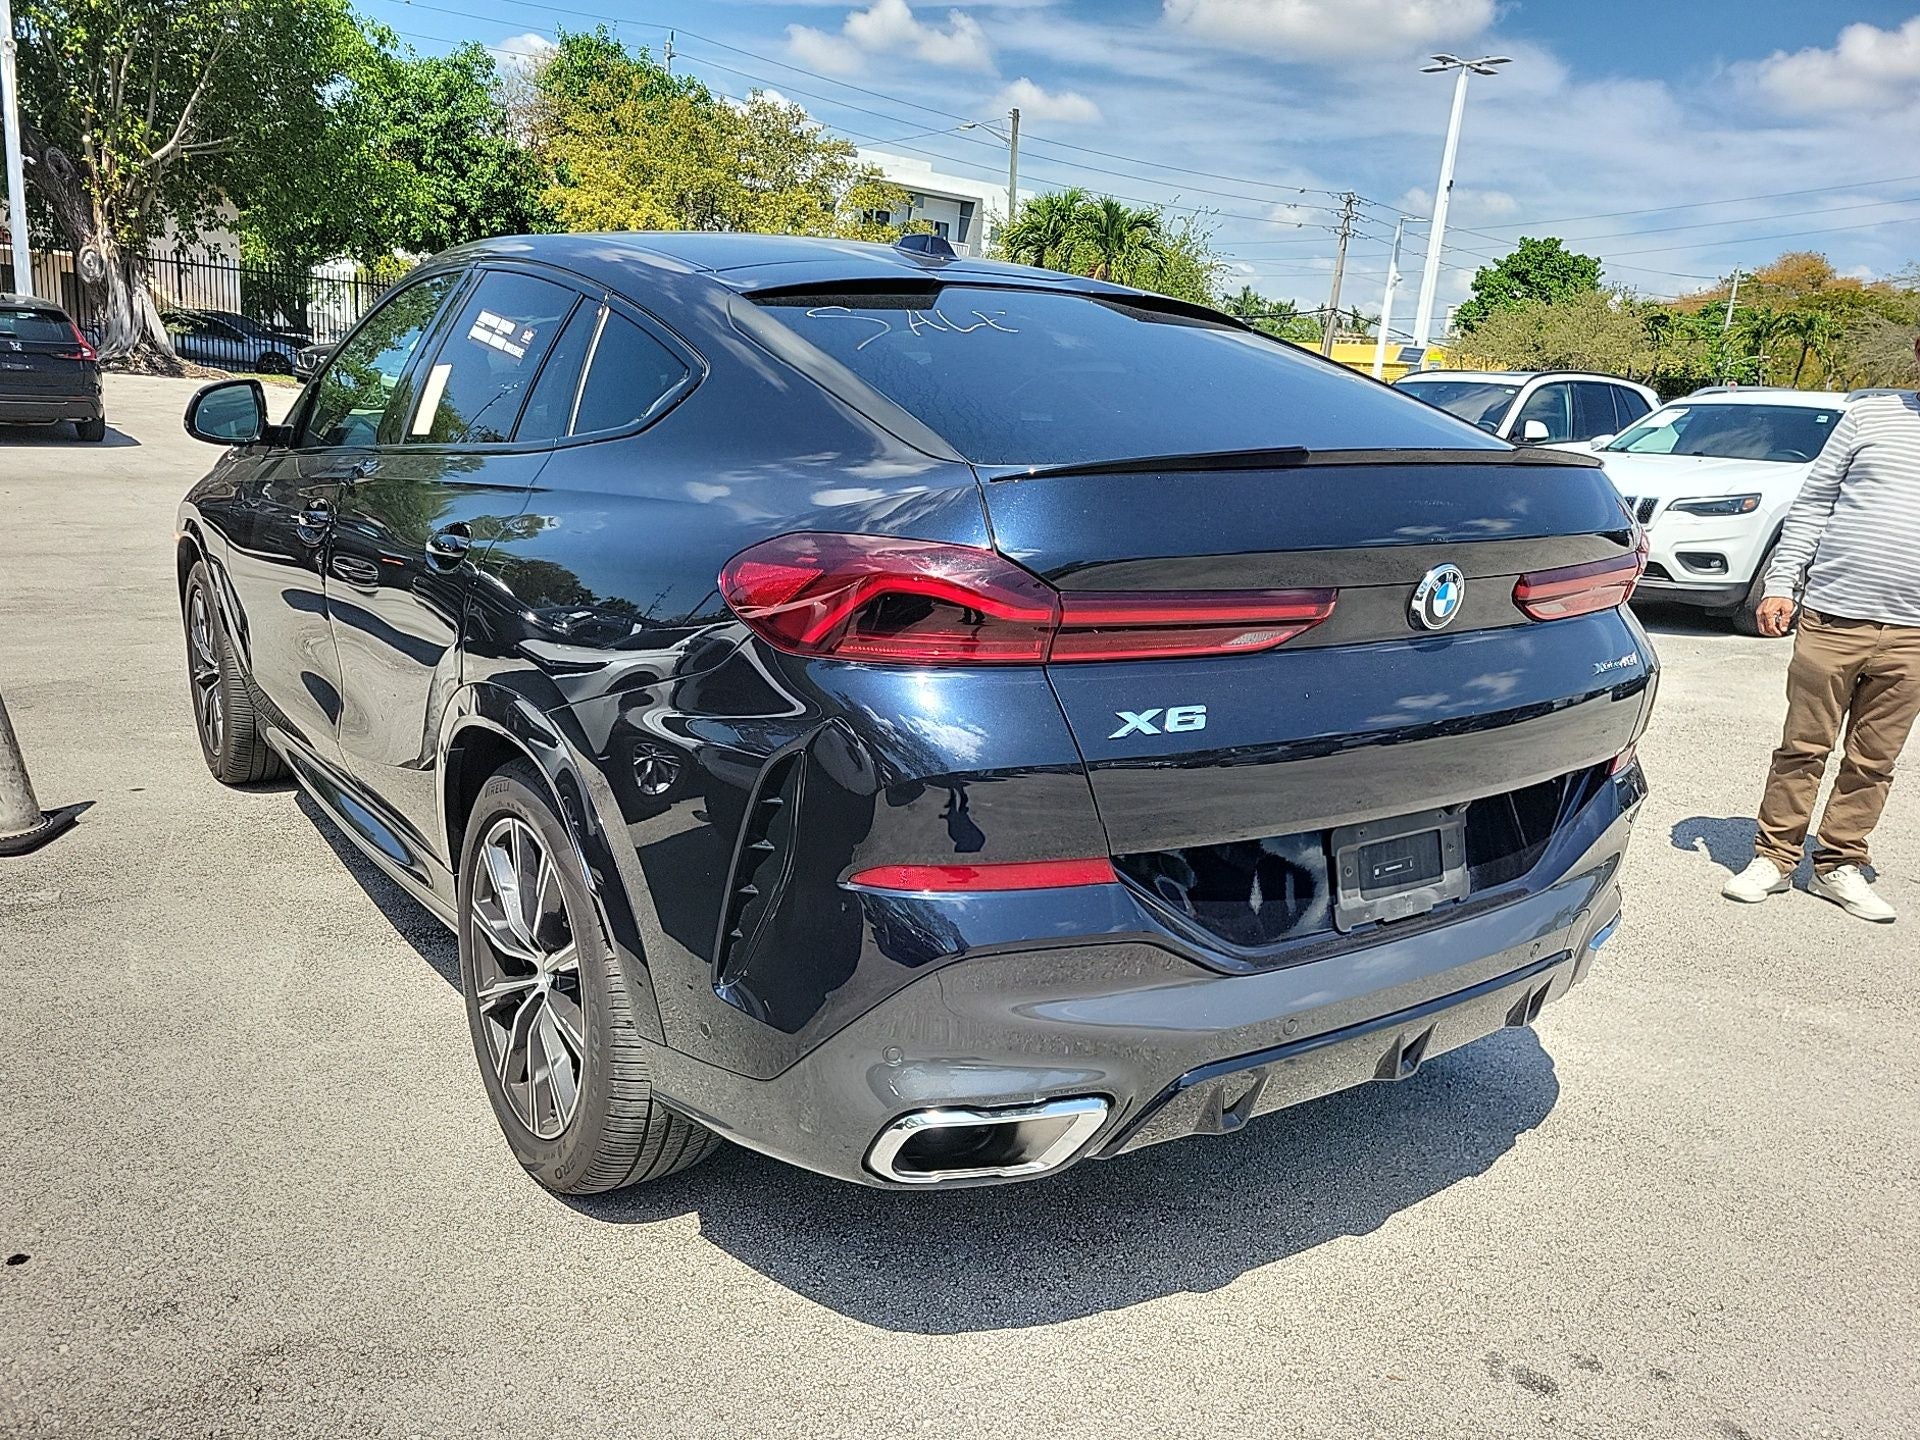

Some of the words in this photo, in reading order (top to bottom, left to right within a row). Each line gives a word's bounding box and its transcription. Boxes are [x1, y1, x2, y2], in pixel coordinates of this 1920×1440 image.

[806, 305, 1020, 351] SALE
[1432, 572, 1463, 593] BMW
[1107, 704, 1207, 740] X6
